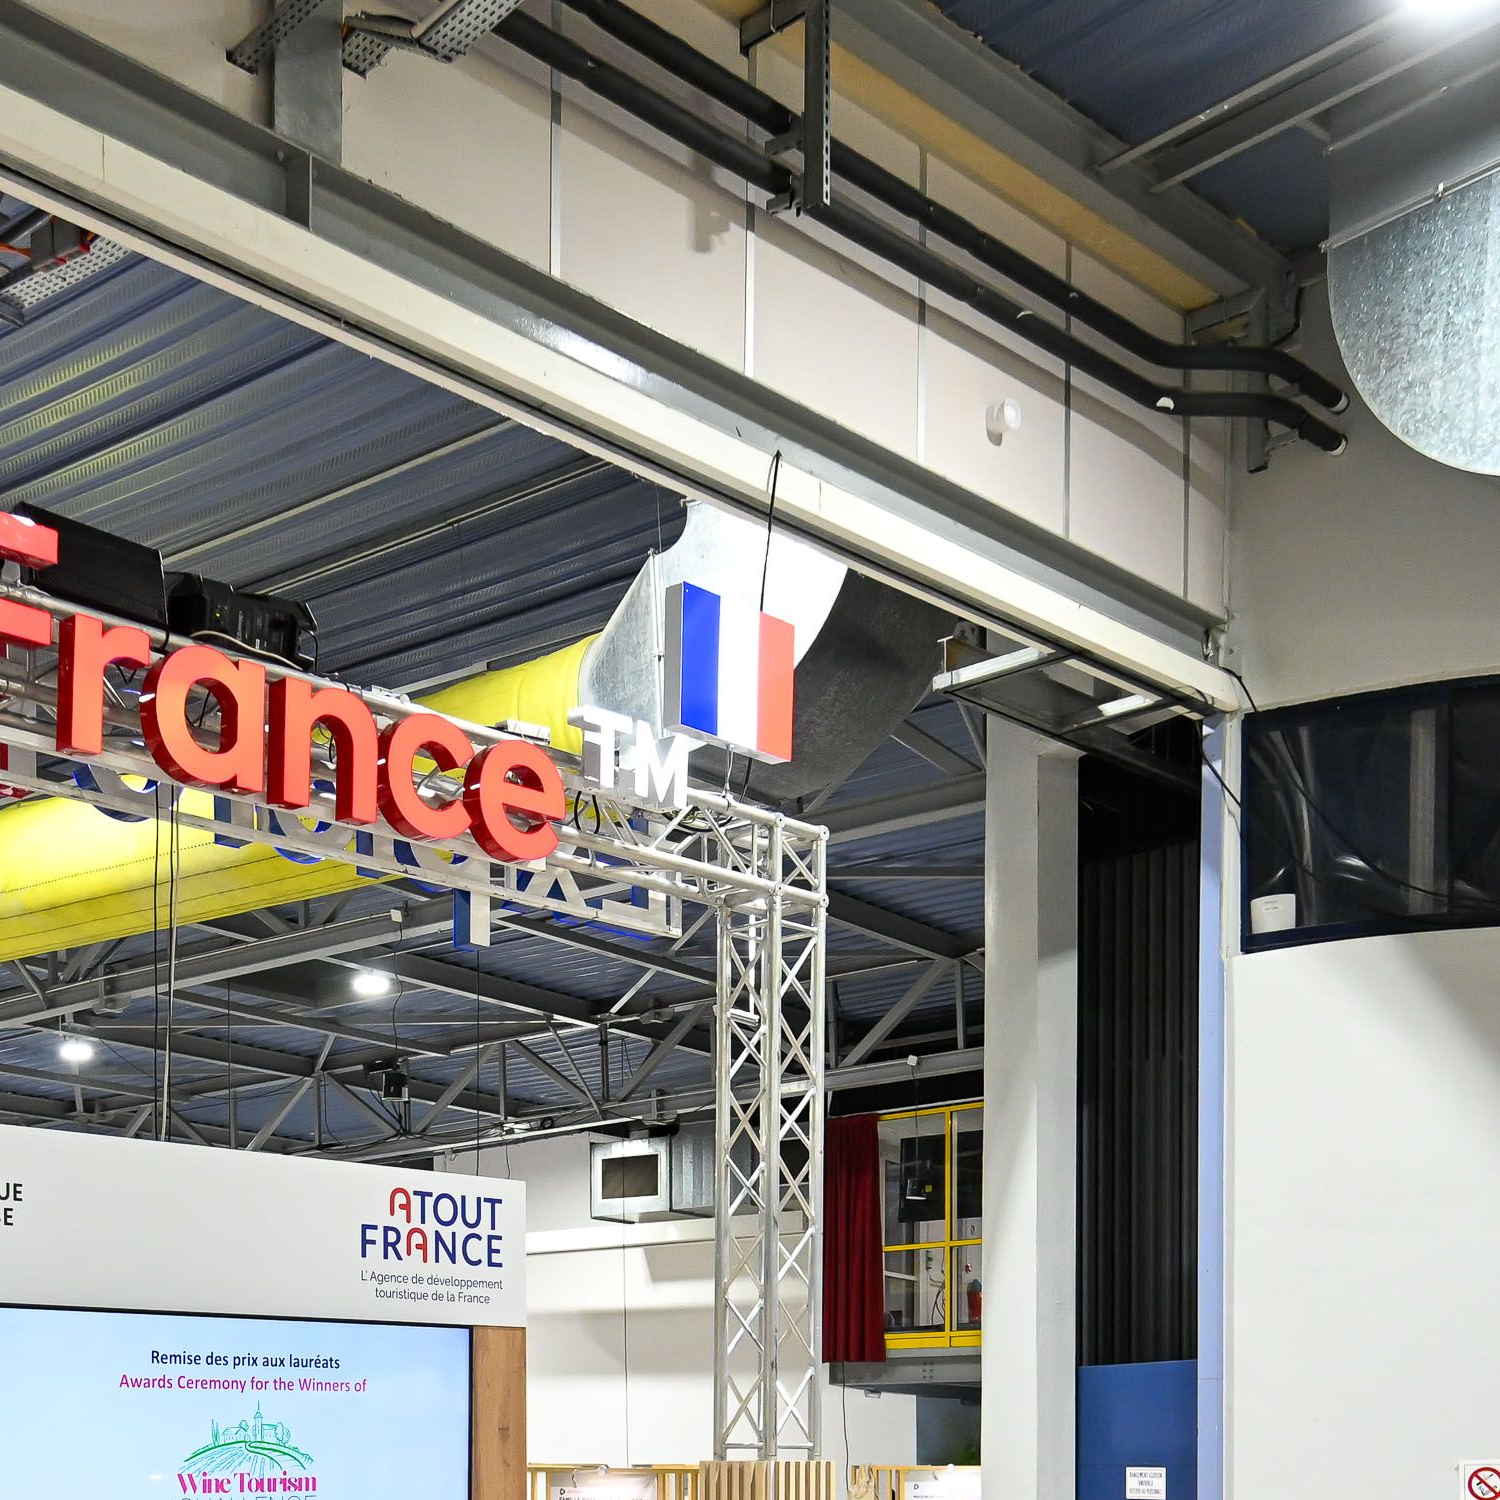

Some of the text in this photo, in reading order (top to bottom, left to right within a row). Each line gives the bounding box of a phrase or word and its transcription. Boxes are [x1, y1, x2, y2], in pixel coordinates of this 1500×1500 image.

[389, 1186, 503, 1231] ATOUT
[360, 1223, 503, 1269] FRANCE
[369, 1272, 408, 1288] Agence
[411, 1274, 425, 1287] de
[427, 1275, 504, 1293] développement
[374, 1287, 491, 1305] touristique de la France
[150, 1350, 341, 1372] Remise des prix aux lauréats
[119, 1374, 368, 1393] Awards Ceremony for the Winners of
[177, 1470, 317, 1495] Wine Tourism
